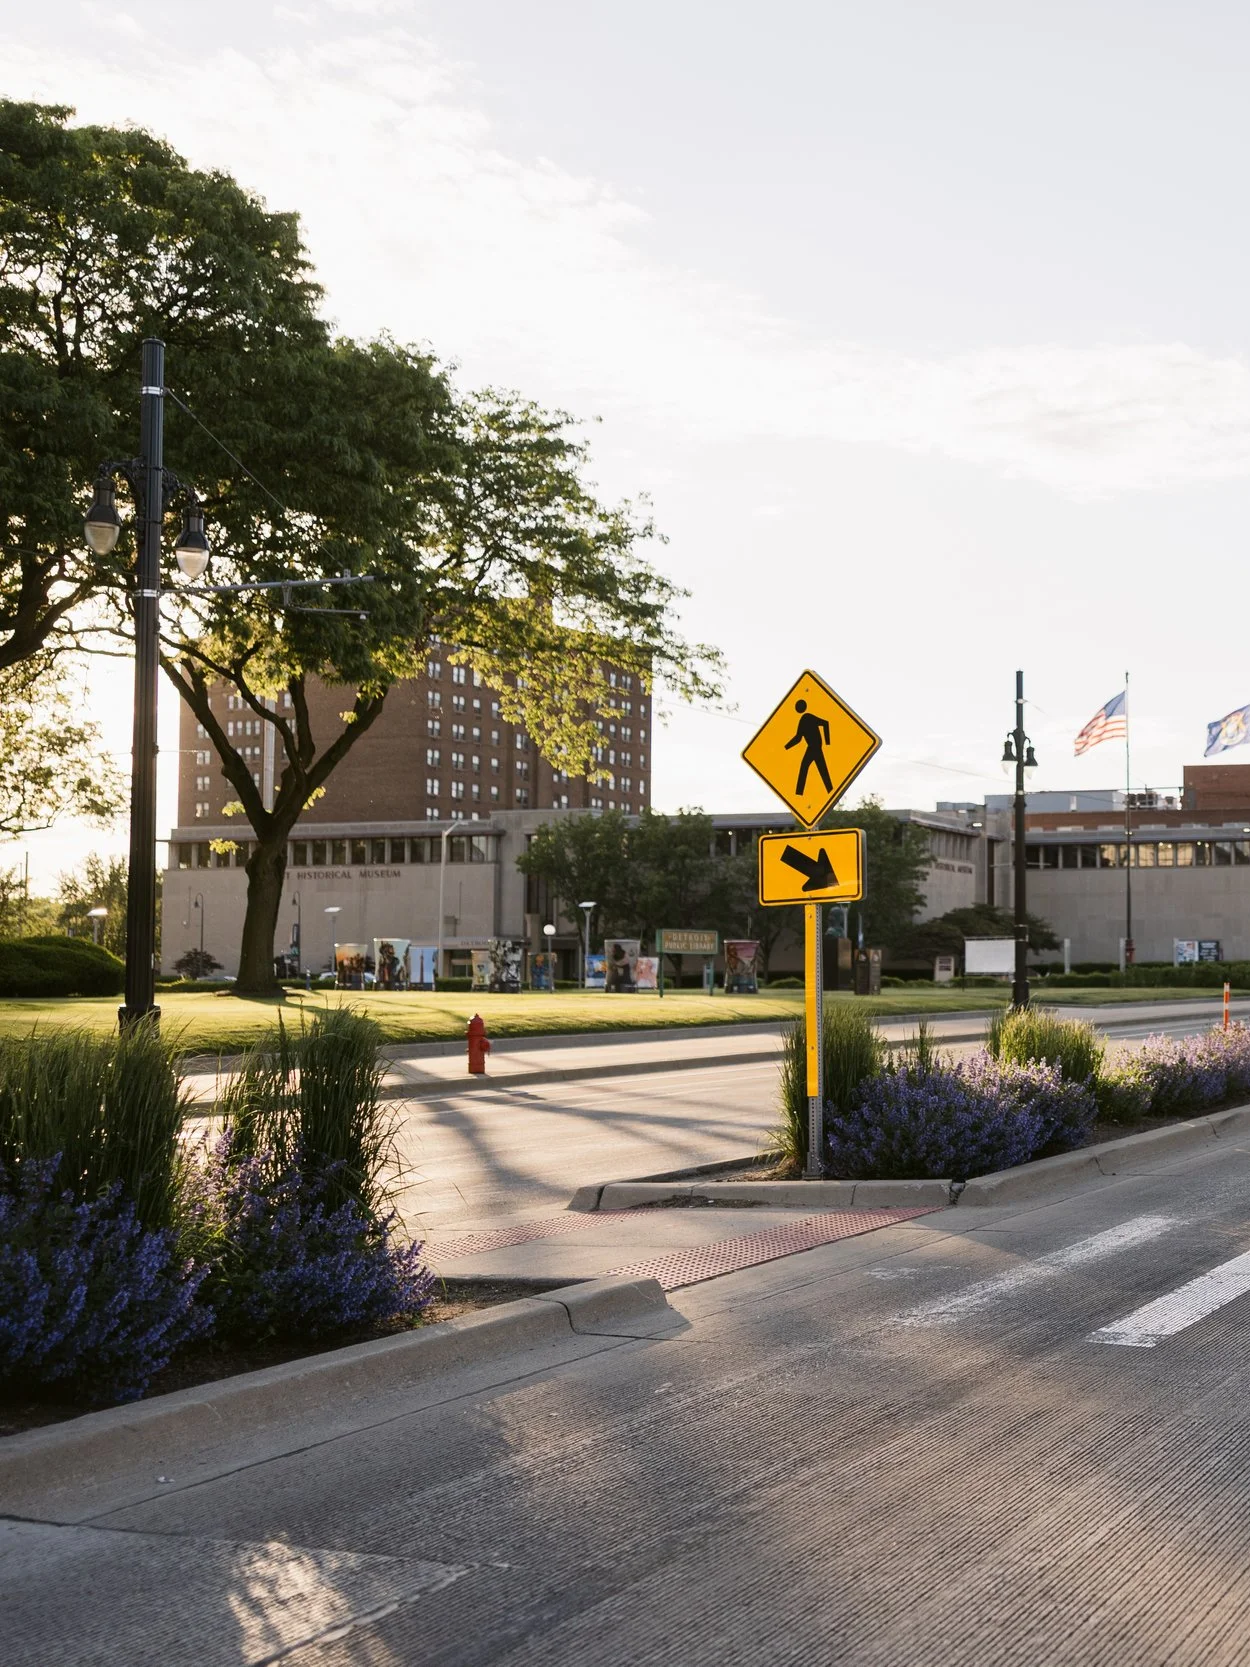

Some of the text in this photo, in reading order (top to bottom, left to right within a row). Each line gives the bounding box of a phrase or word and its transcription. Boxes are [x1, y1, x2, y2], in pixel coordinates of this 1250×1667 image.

[297, 870, 352, 880] HISTORICAL
[359, 869, 401, 879] MUSEUM
[672, 932, 709, 941] DETROIT
[664, 942, 714, 951] PUBLIC LIBRARY
